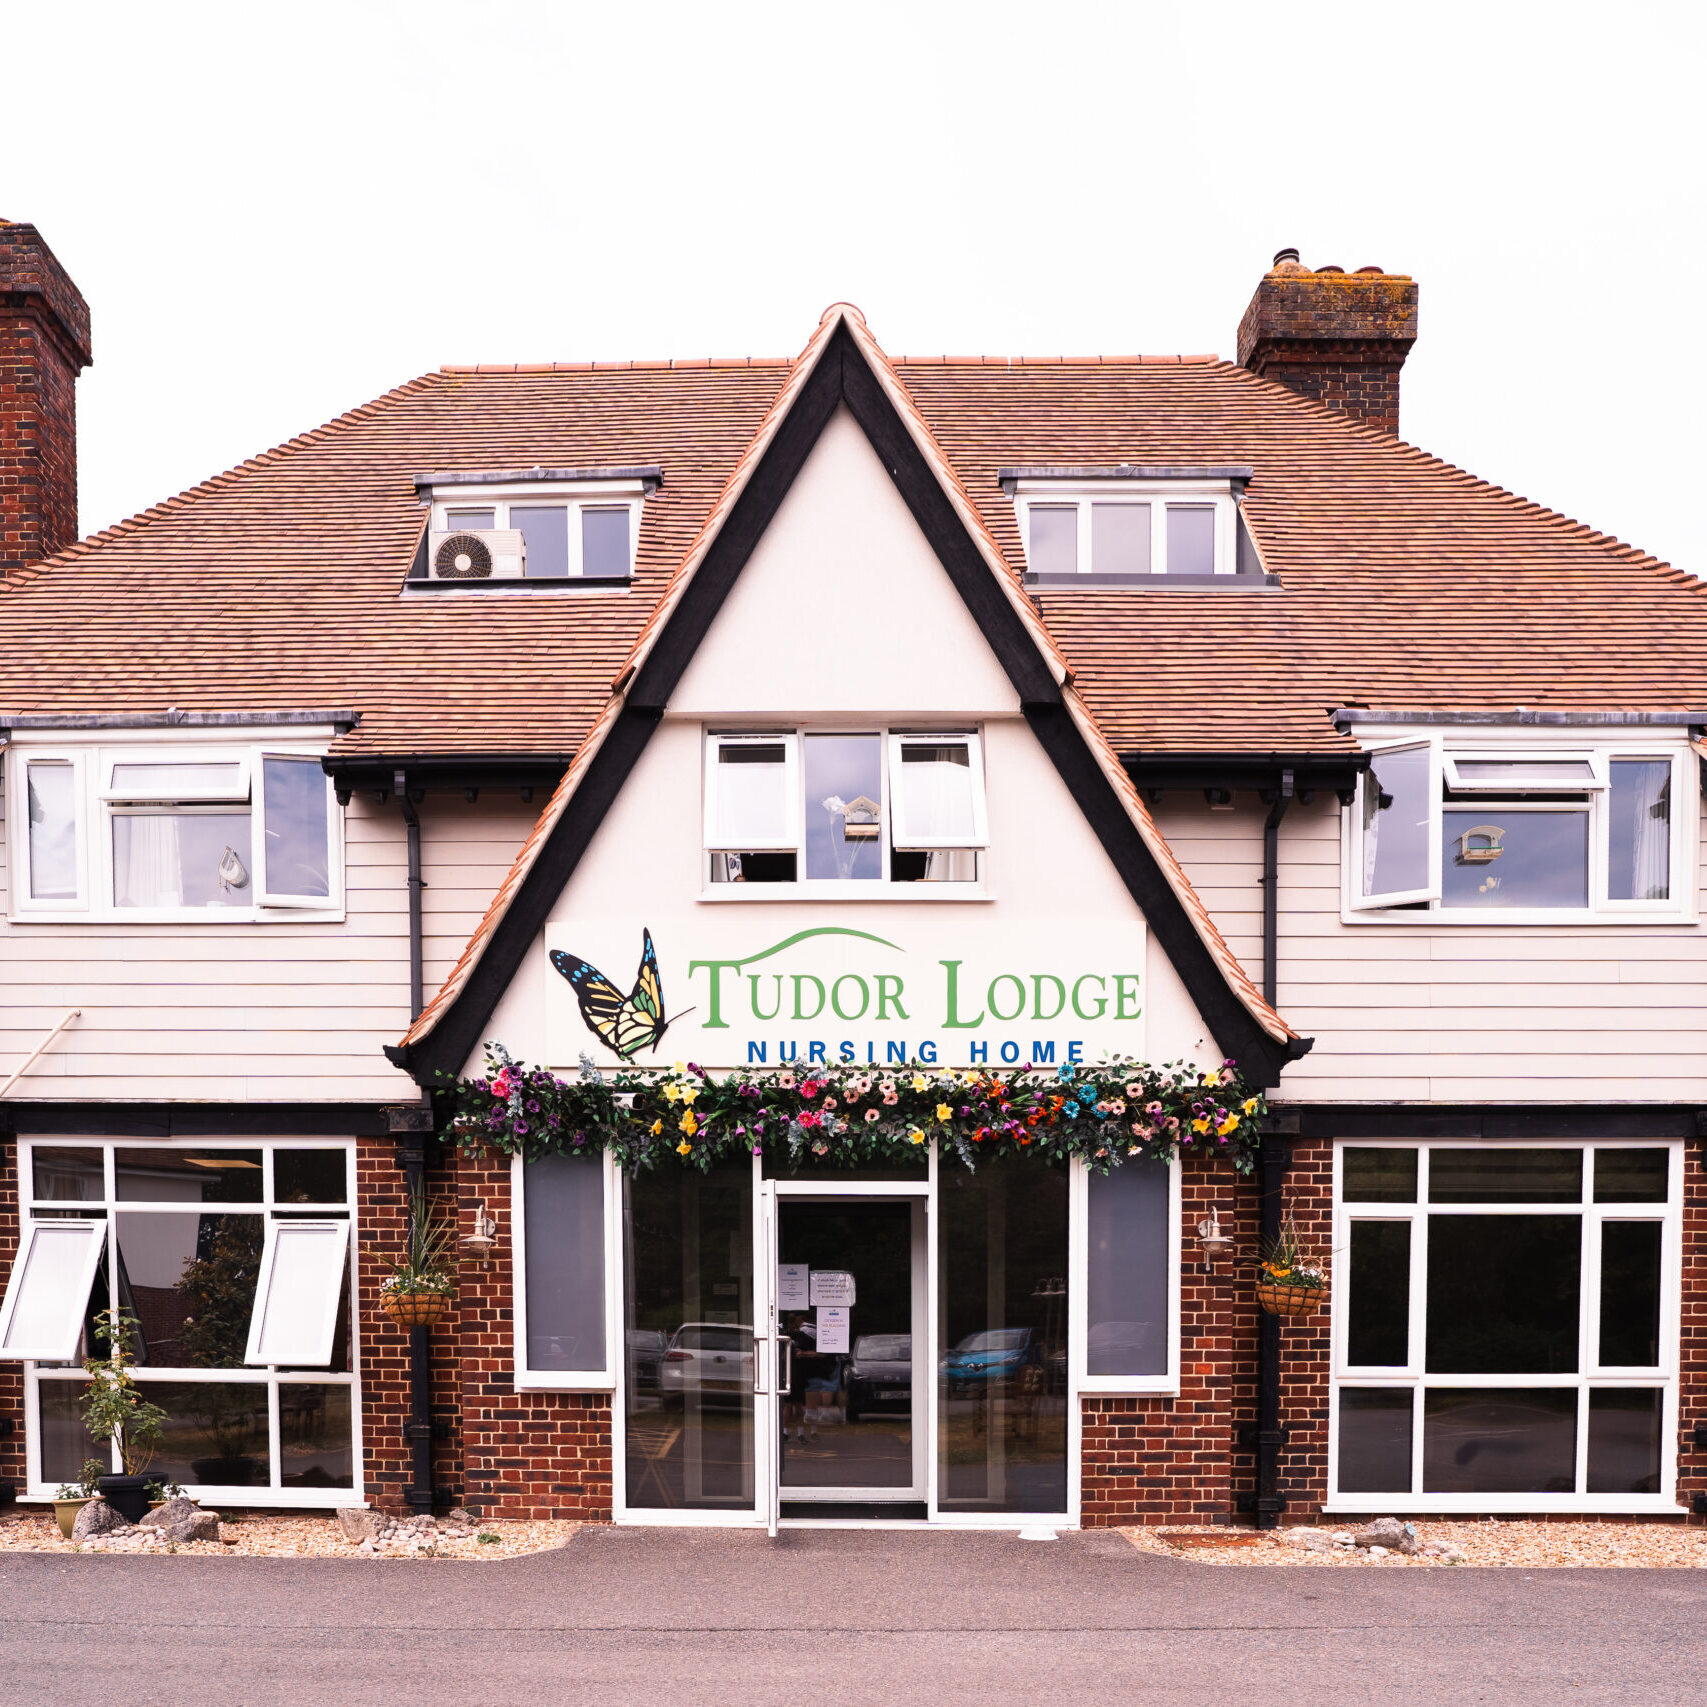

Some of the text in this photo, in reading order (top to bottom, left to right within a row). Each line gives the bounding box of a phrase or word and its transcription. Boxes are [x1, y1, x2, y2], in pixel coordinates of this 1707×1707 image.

[689, 960, 1143, 1028] TUDOR LODGE
[748, 1041, 1084, 1064] NURSING HOME
